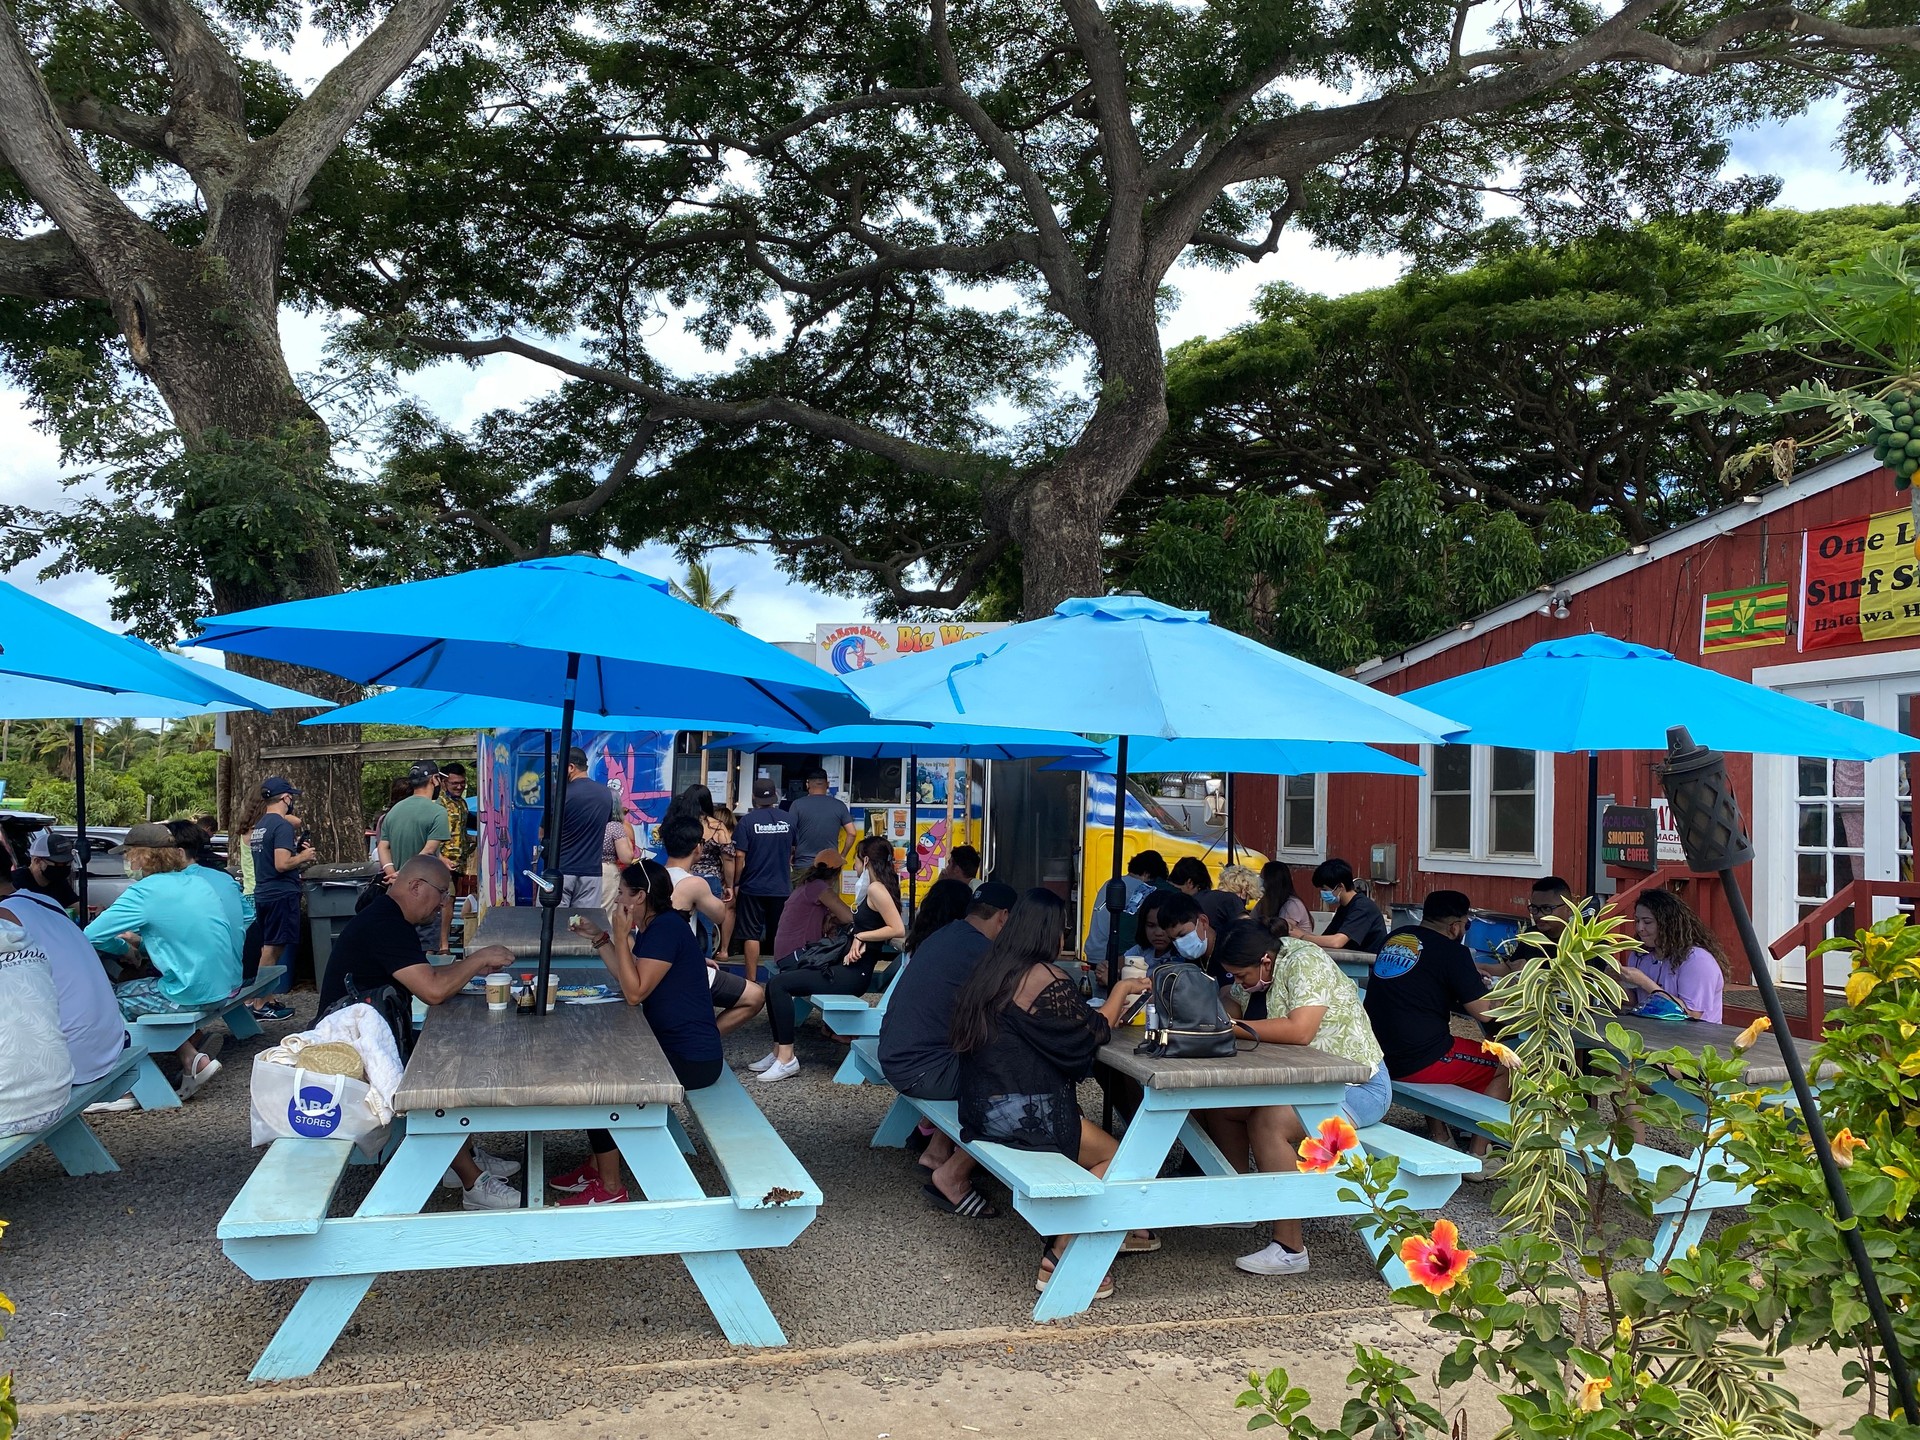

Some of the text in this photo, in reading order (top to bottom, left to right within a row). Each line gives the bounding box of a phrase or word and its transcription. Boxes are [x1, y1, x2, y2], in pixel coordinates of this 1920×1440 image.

[1819, 532, 1885, 559] One
[1807, 564, 1920, 606] Surf S
[1814, 608, 1895, 632] Haleiwa
[896, 625, 935, 652] Big
[1608, 831, 1644, 845] SMOOTHIES
[1620, 849, 1625, 861] &
[1627, 848, 1649, 862] COFFEE
[1657, 846, 1678, 854] ailable
[328, 866, 365, 874] TRASH
[294, 1098, 336, 1117] ABC
[295, 1115, 332, 1128] STORES
